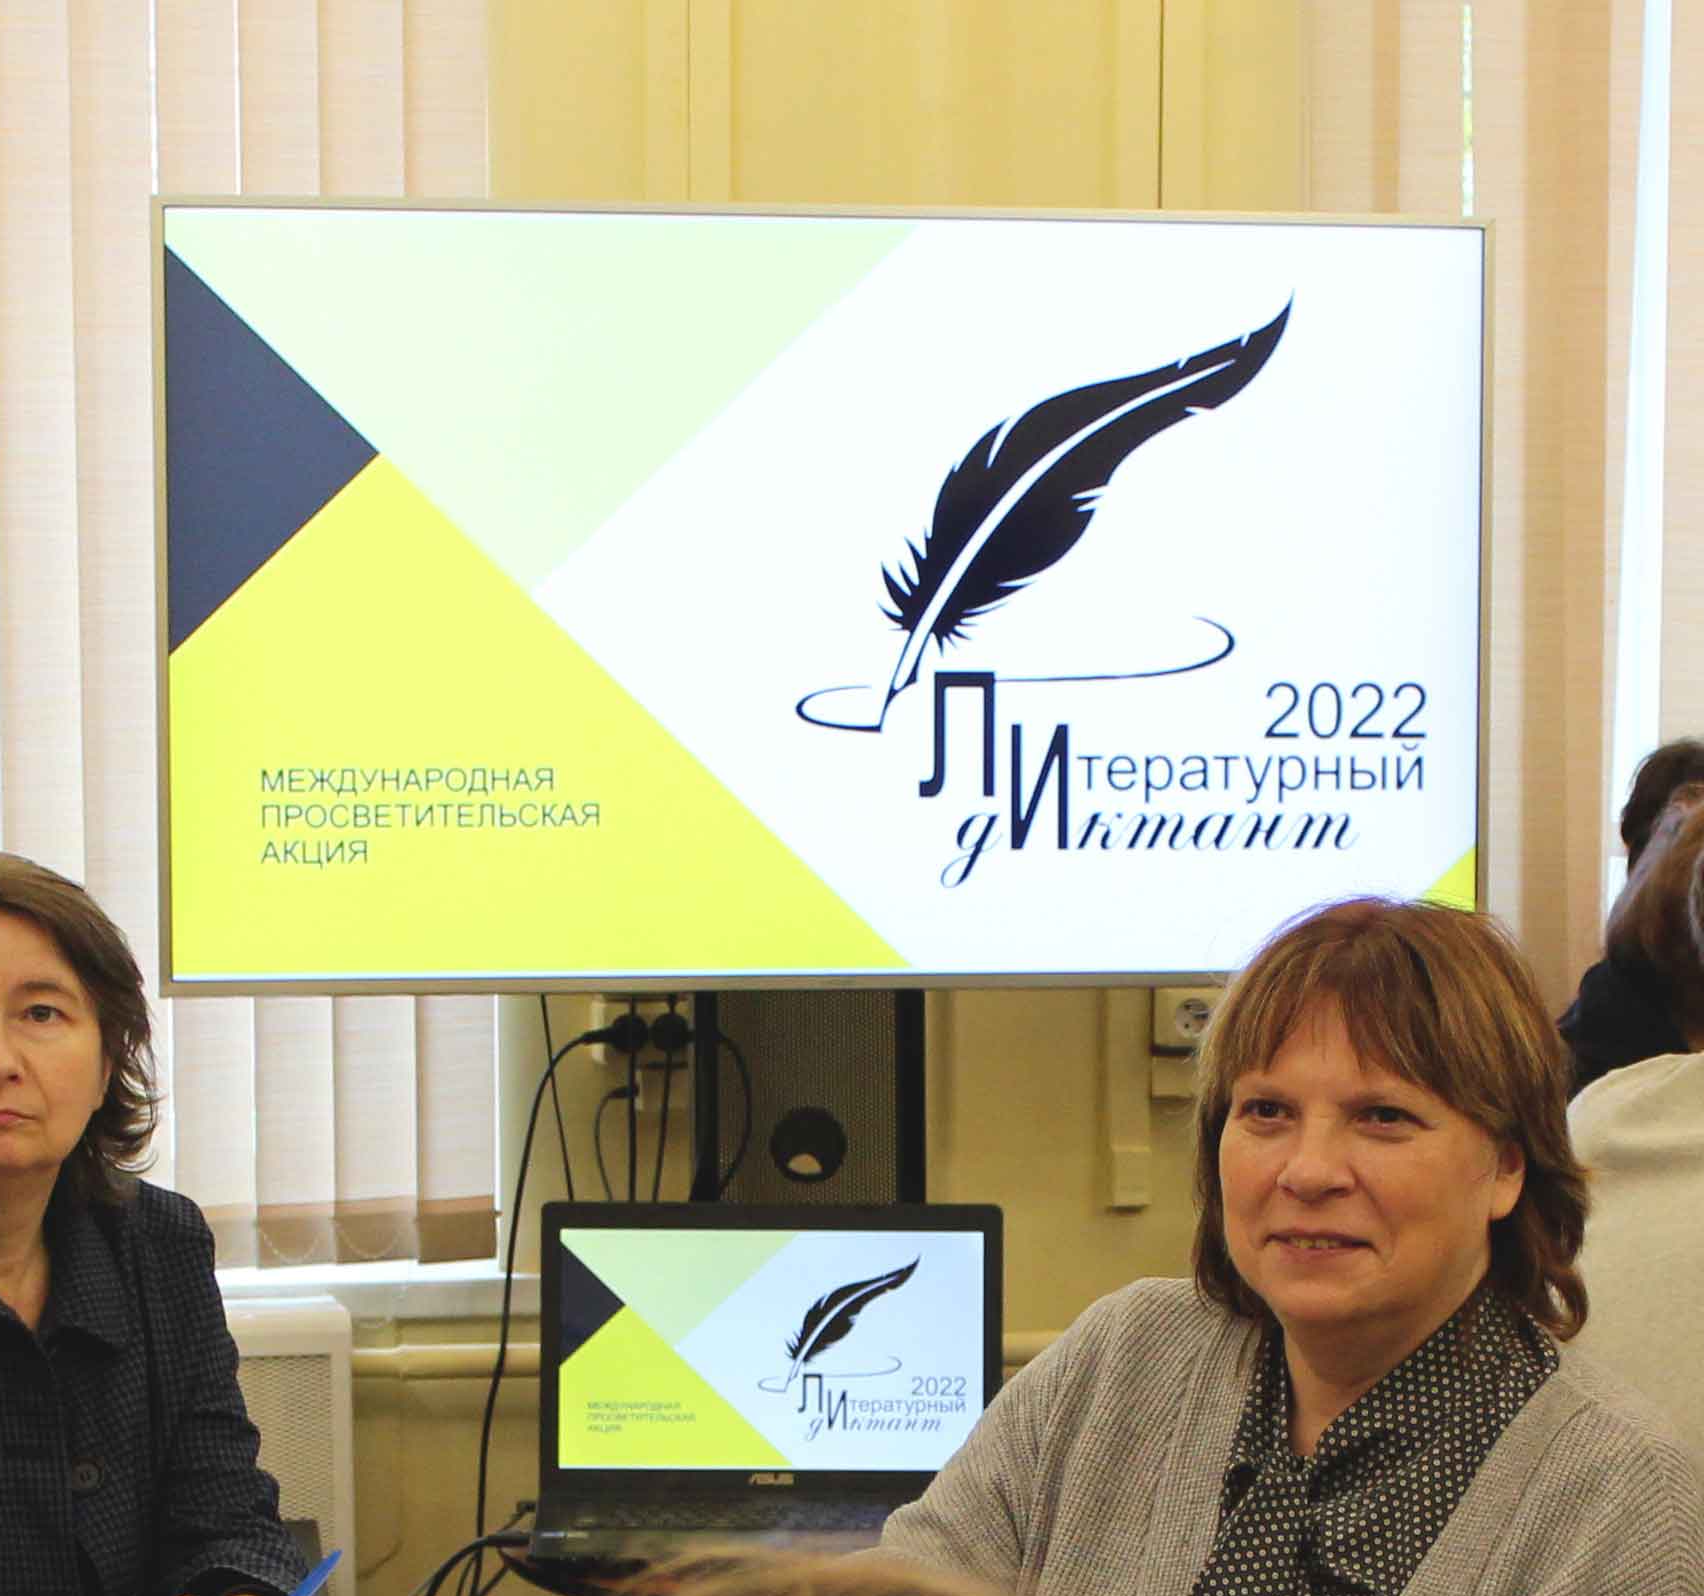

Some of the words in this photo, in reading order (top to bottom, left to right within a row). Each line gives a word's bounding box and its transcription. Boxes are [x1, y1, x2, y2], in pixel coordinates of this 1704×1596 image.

[1264, 682, 1428, 740] 2022
[260, 767, 555, 797] МЕЖДУНАРОДНАЯ
[260, 802, 601, 829] ПРОСВЕТИТЕЛЬСКАЯ
[259, 839, 369, 870] АКЦИЯ
[911, 1375, 968, 1397] 2022
